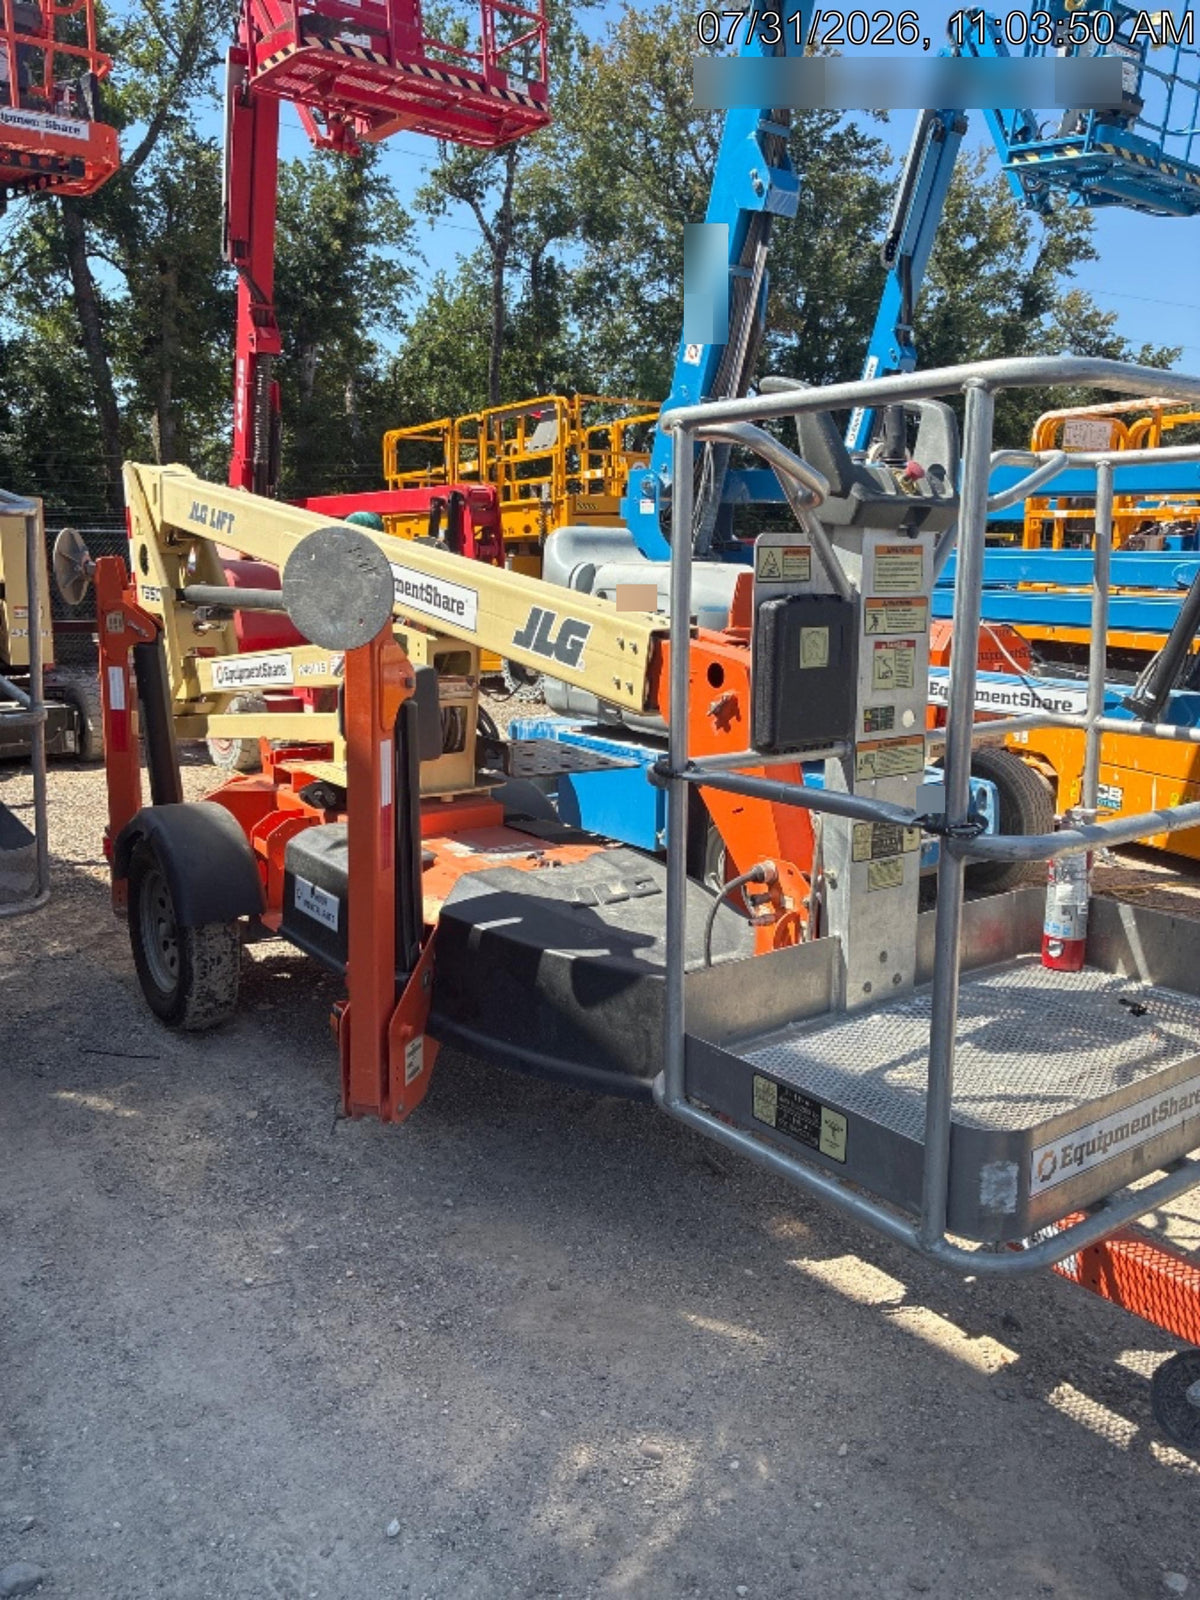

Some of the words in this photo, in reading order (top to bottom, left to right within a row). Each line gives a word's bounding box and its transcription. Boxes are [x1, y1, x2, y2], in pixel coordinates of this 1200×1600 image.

[393, 577, 466, 617] mentShare
[511, 605, 593, 669] JLG
[928, 682, 1073, 712] EqmentShare
